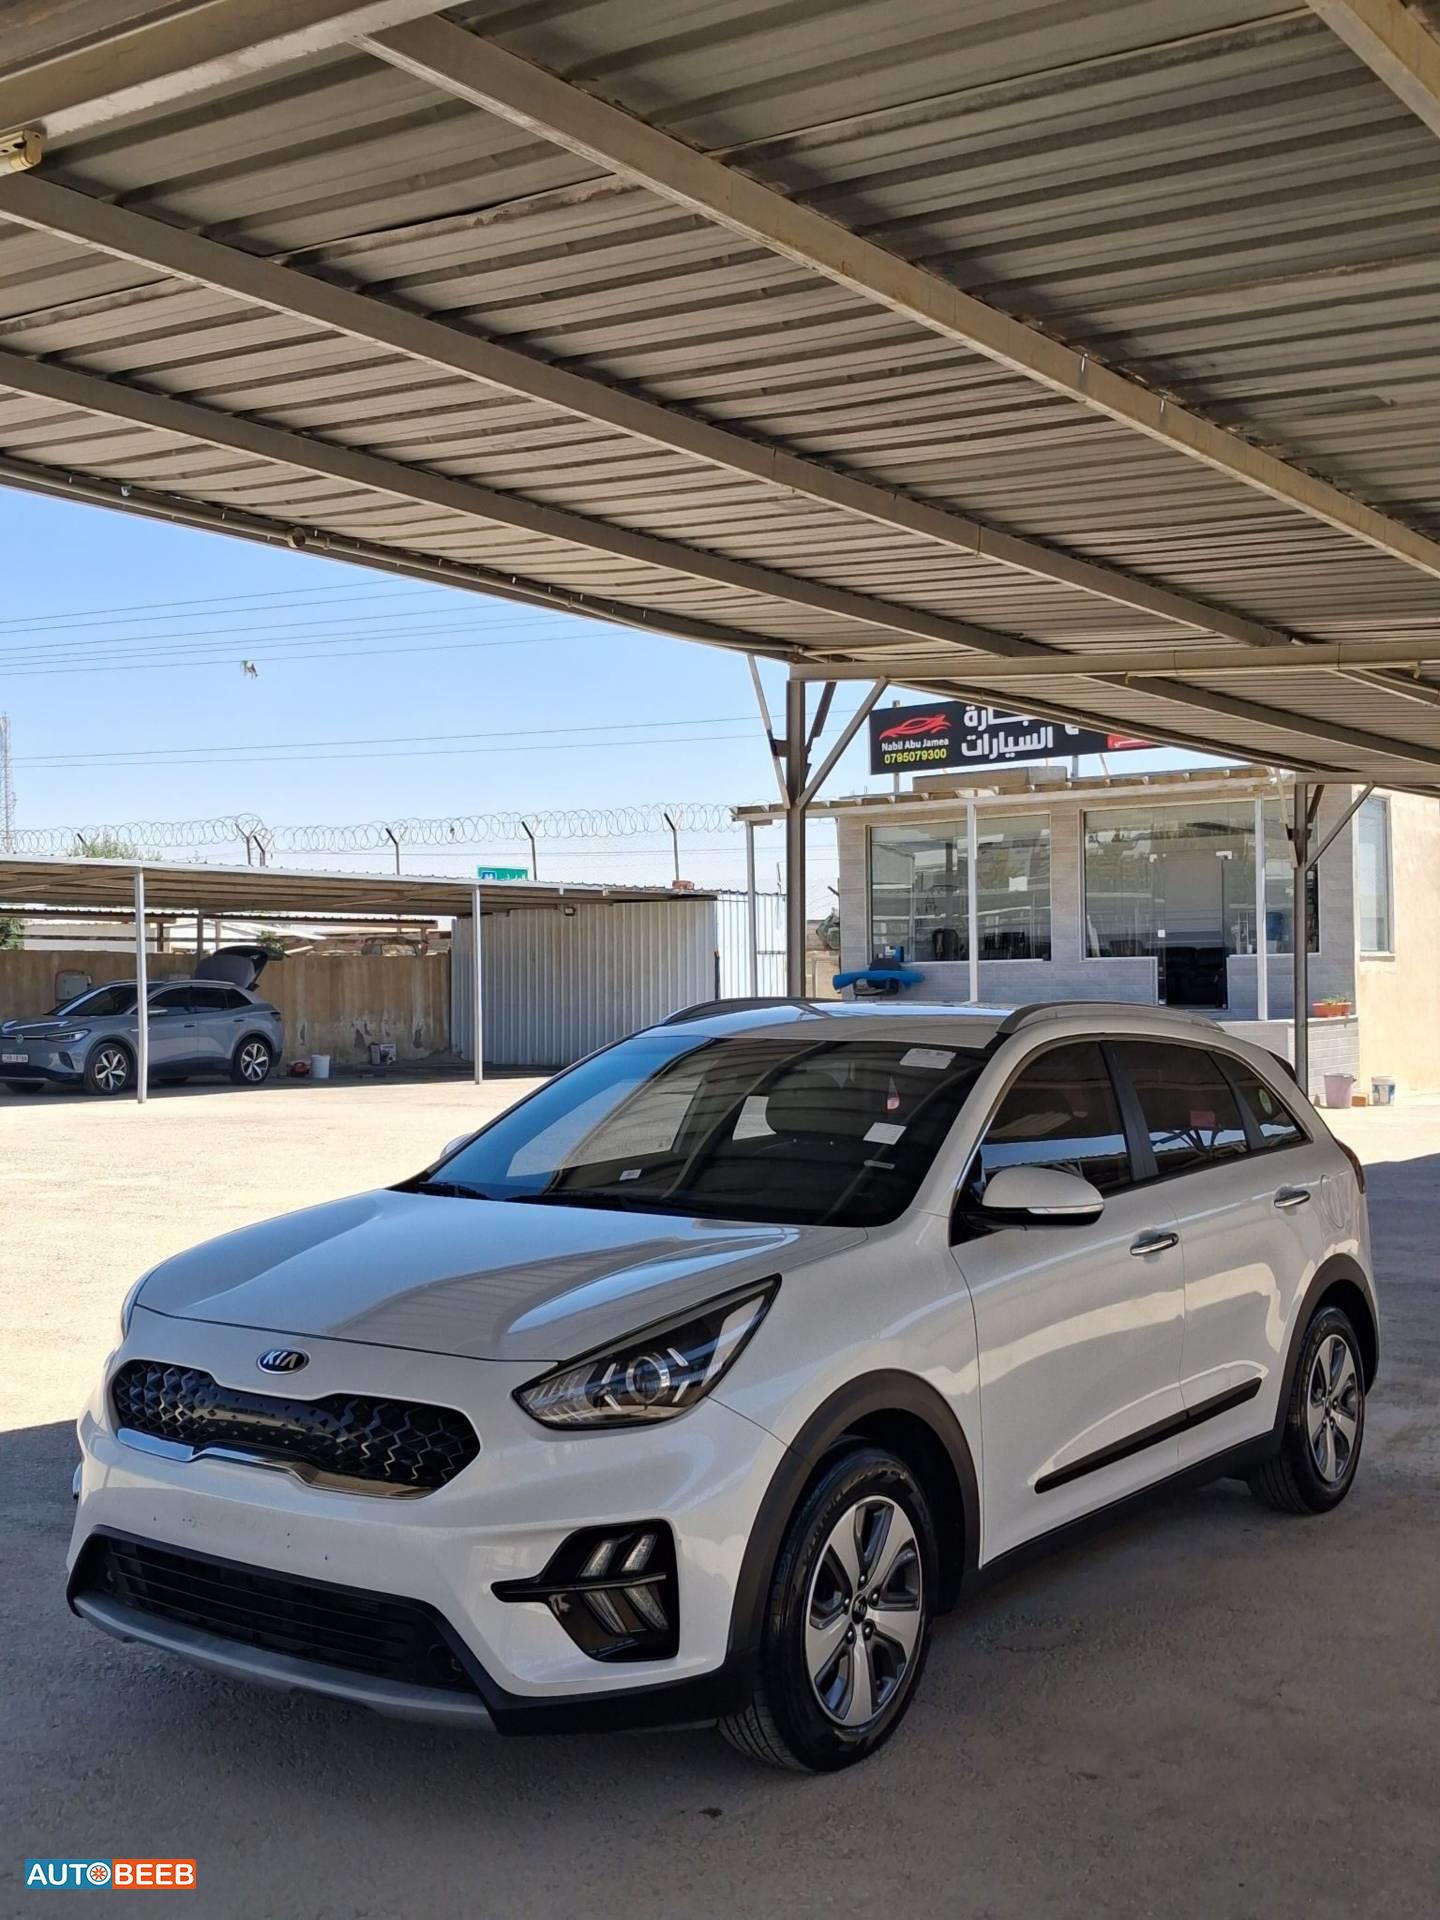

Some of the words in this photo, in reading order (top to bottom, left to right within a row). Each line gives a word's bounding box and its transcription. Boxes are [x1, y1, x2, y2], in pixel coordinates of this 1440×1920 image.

[881, 741, 903, 752] Nabil
[904, 739, 921, 749] Abu
[922, 738, 949, 748] Jamea
[961, 726, 1053, 760] السيارات
[262, 1351, 298, 1369] KIA
